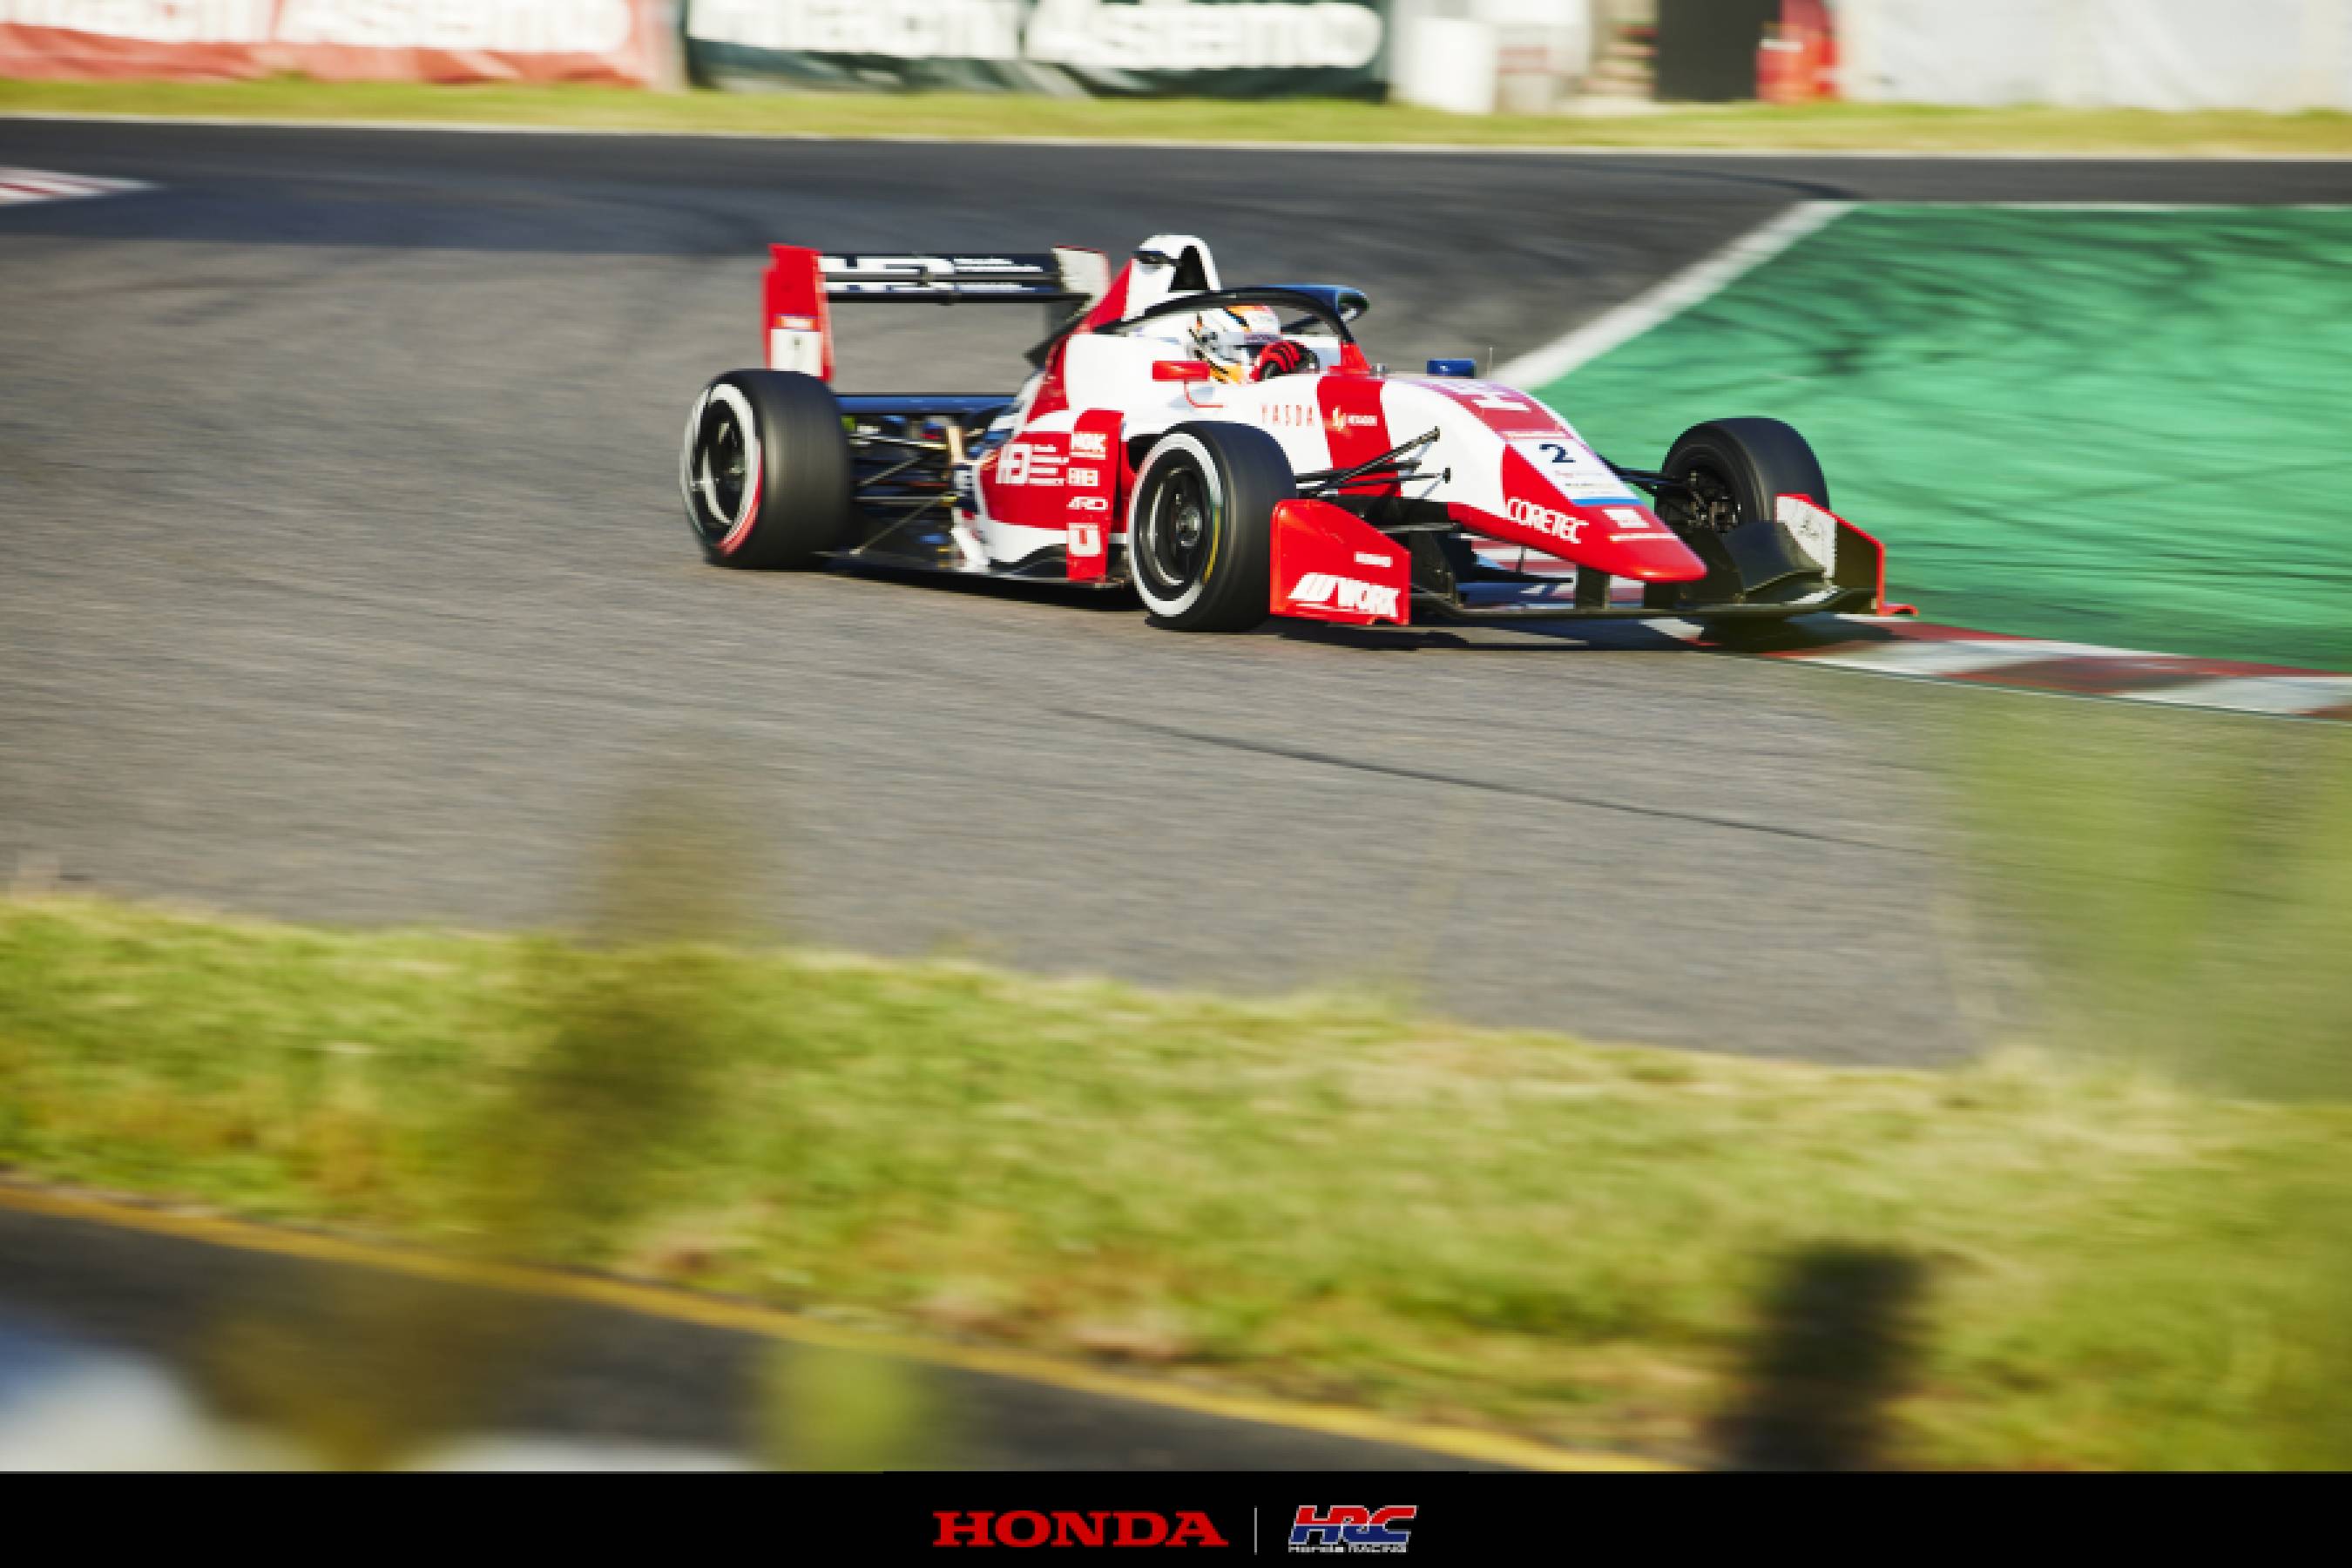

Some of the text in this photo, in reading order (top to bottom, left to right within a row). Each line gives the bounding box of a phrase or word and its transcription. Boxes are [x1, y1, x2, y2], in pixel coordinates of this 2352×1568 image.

[1539, 443, 1576, 463] 2
[1505, 496, 1590, 544] CORETEC
[1337, 576, 1402, 619] WORK
